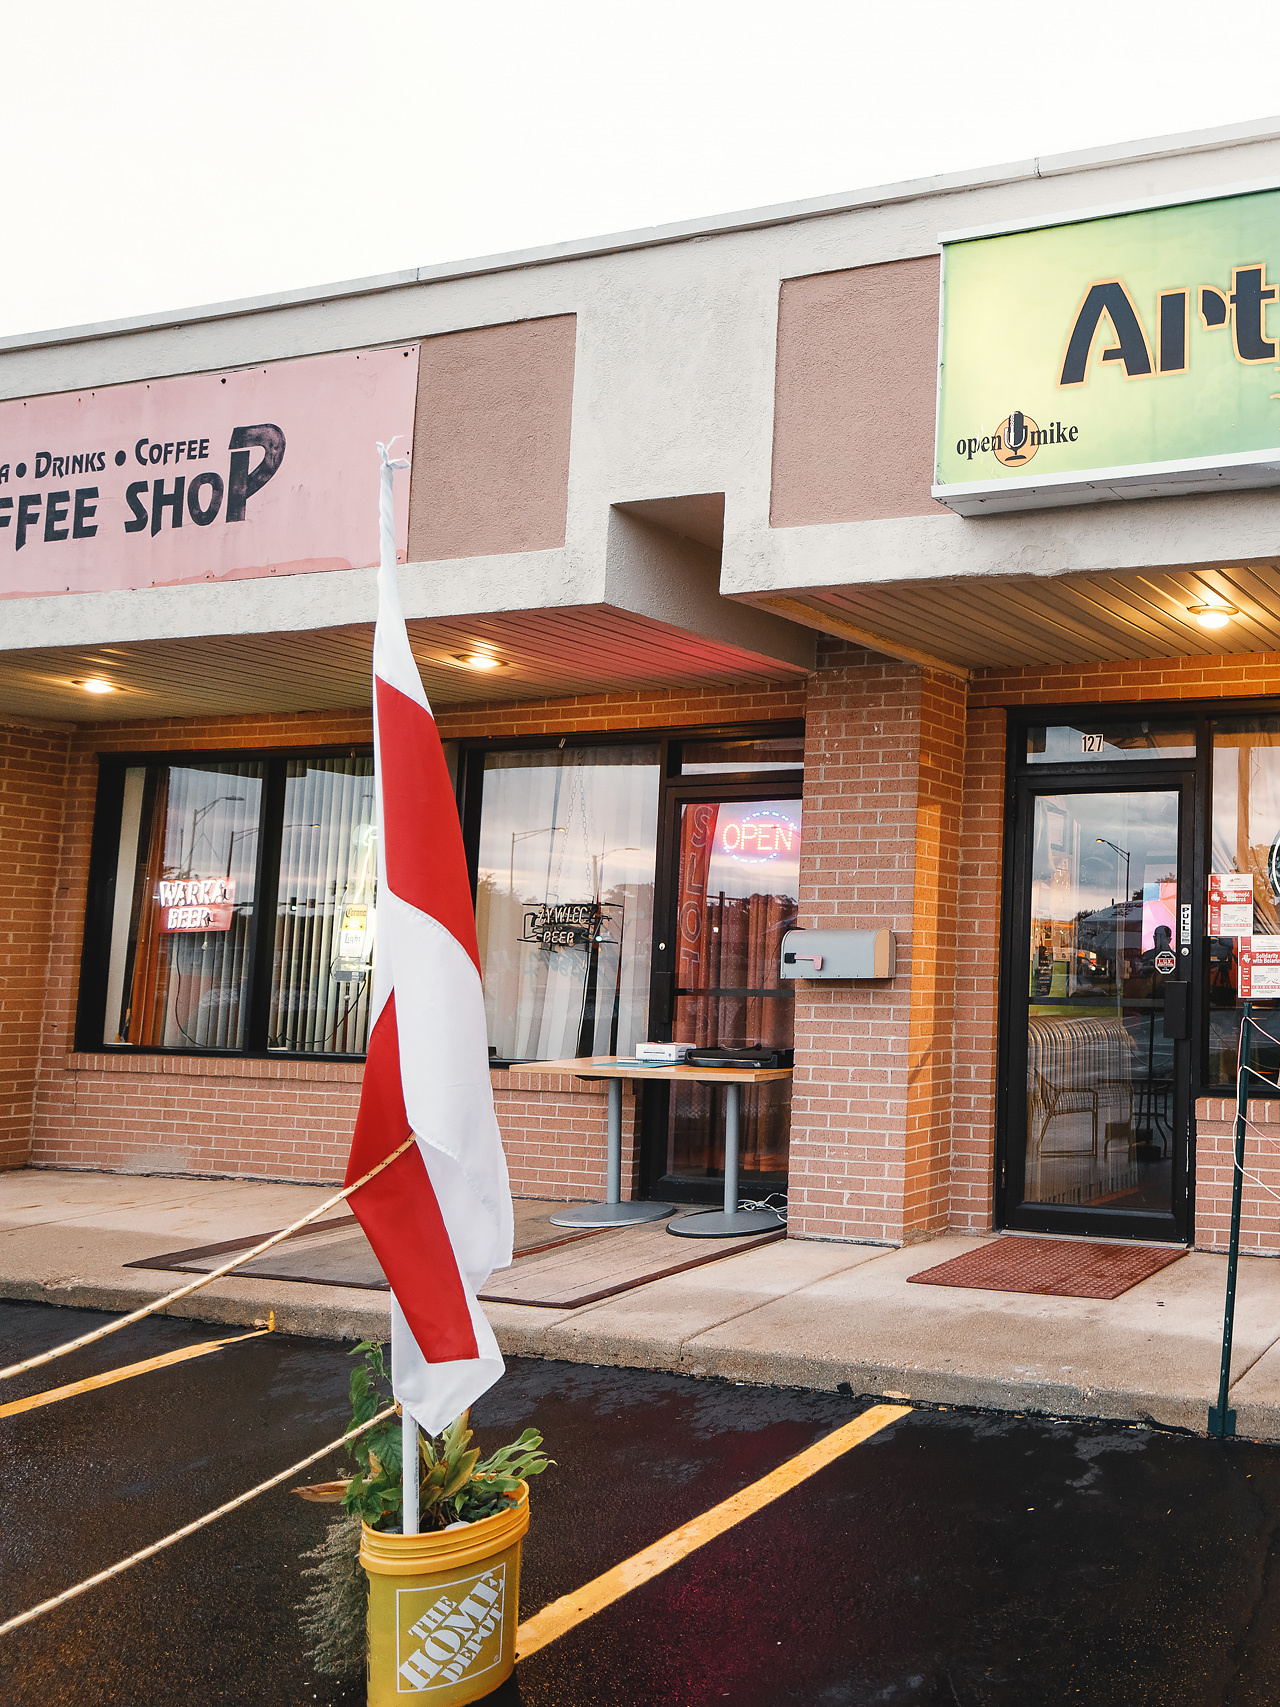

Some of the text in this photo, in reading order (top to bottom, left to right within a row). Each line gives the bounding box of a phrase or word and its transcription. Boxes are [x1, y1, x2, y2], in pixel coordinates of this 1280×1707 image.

[1056, 262, 1280, 390] Art
[955, 420, 1080, 460] open mike
[34, 451, 106, 479] DRINKS
[134, 437, 210, 466] COFFEE
[124, 422, 286, 538] SHOP
[1081, 734, 1102, 752] 127
[722, 823, 793, 851] OPEN
[159, 880, 227, 907] WARKA
[167, 907, 213, 930] BEER
[346, 907, 367, 918] Corona
[1182, 907, 1190, 932] PULL
[1255, 952, 1279, 960] Solidarity
[398, 1570, 505, 1691] HOME
[408, 1595, 458, 1640] THE
[440, 1601, 503, 1683] DEPOT
